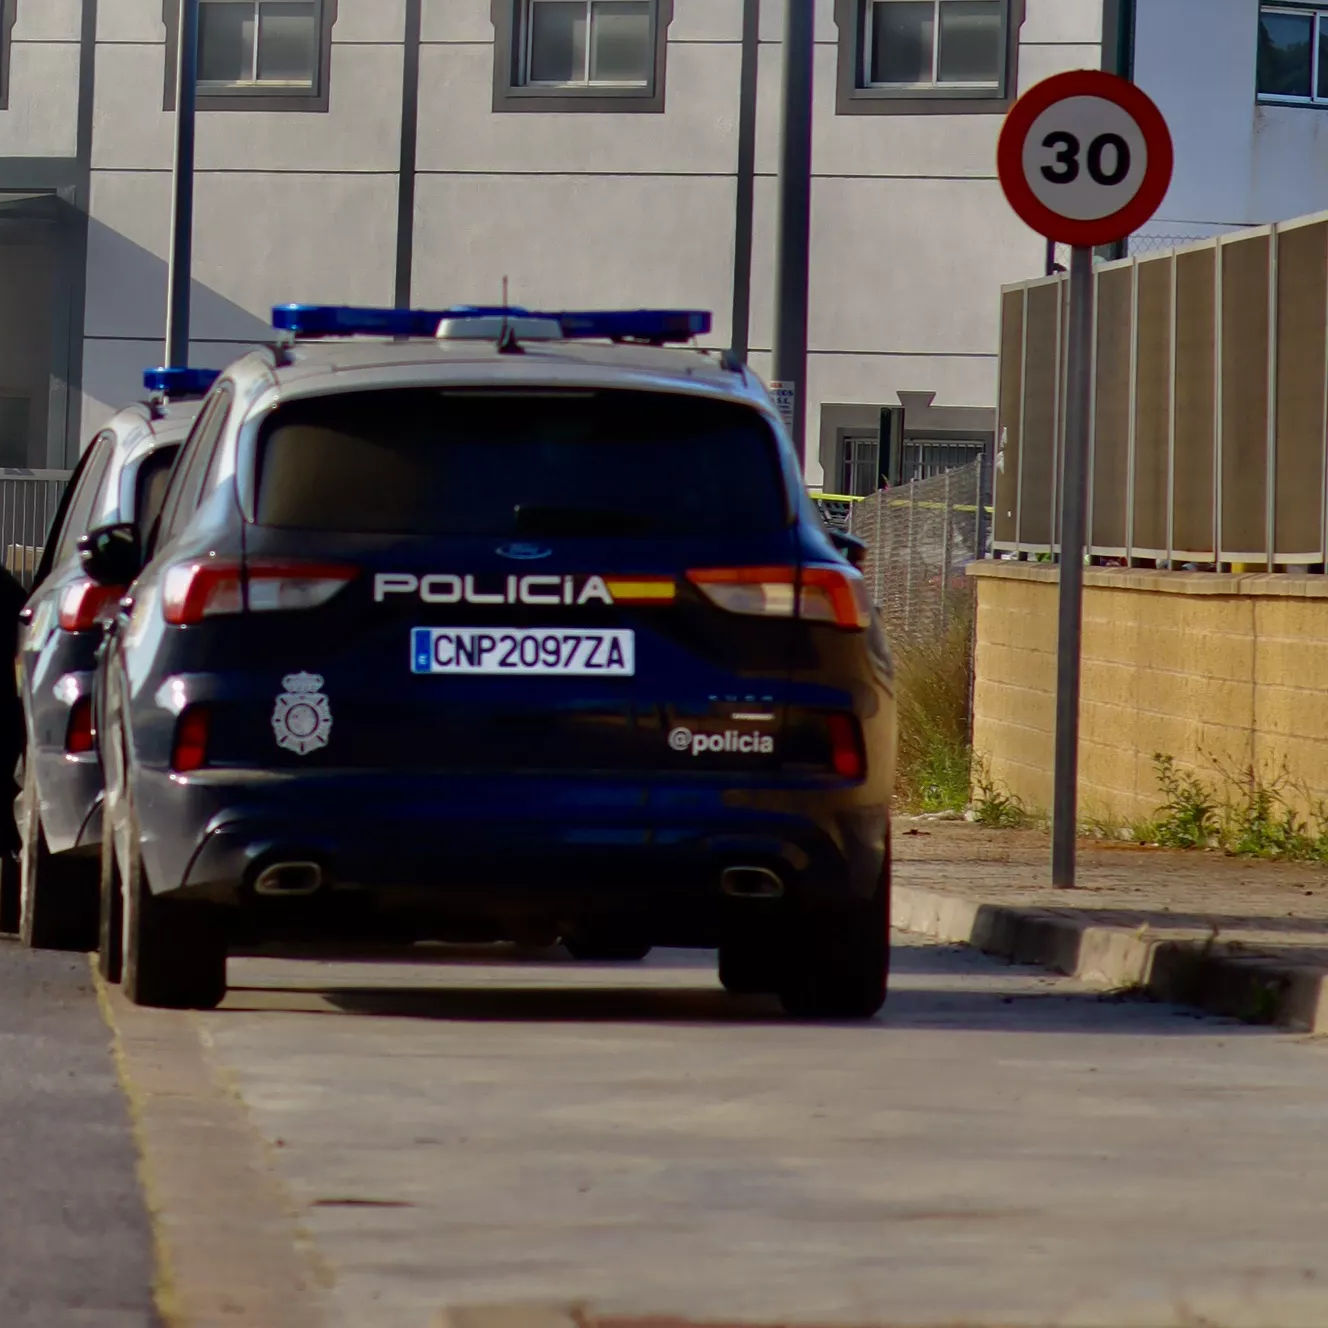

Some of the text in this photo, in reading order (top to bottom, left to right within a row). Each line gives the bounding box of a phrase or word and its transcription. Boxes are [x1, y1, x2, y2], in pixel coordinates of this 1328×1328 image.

[1040, 131, 1131, 186] 30
[433, 634, 625, 669] CNP2097ZA
[668, 727, 774, 755] @policia
